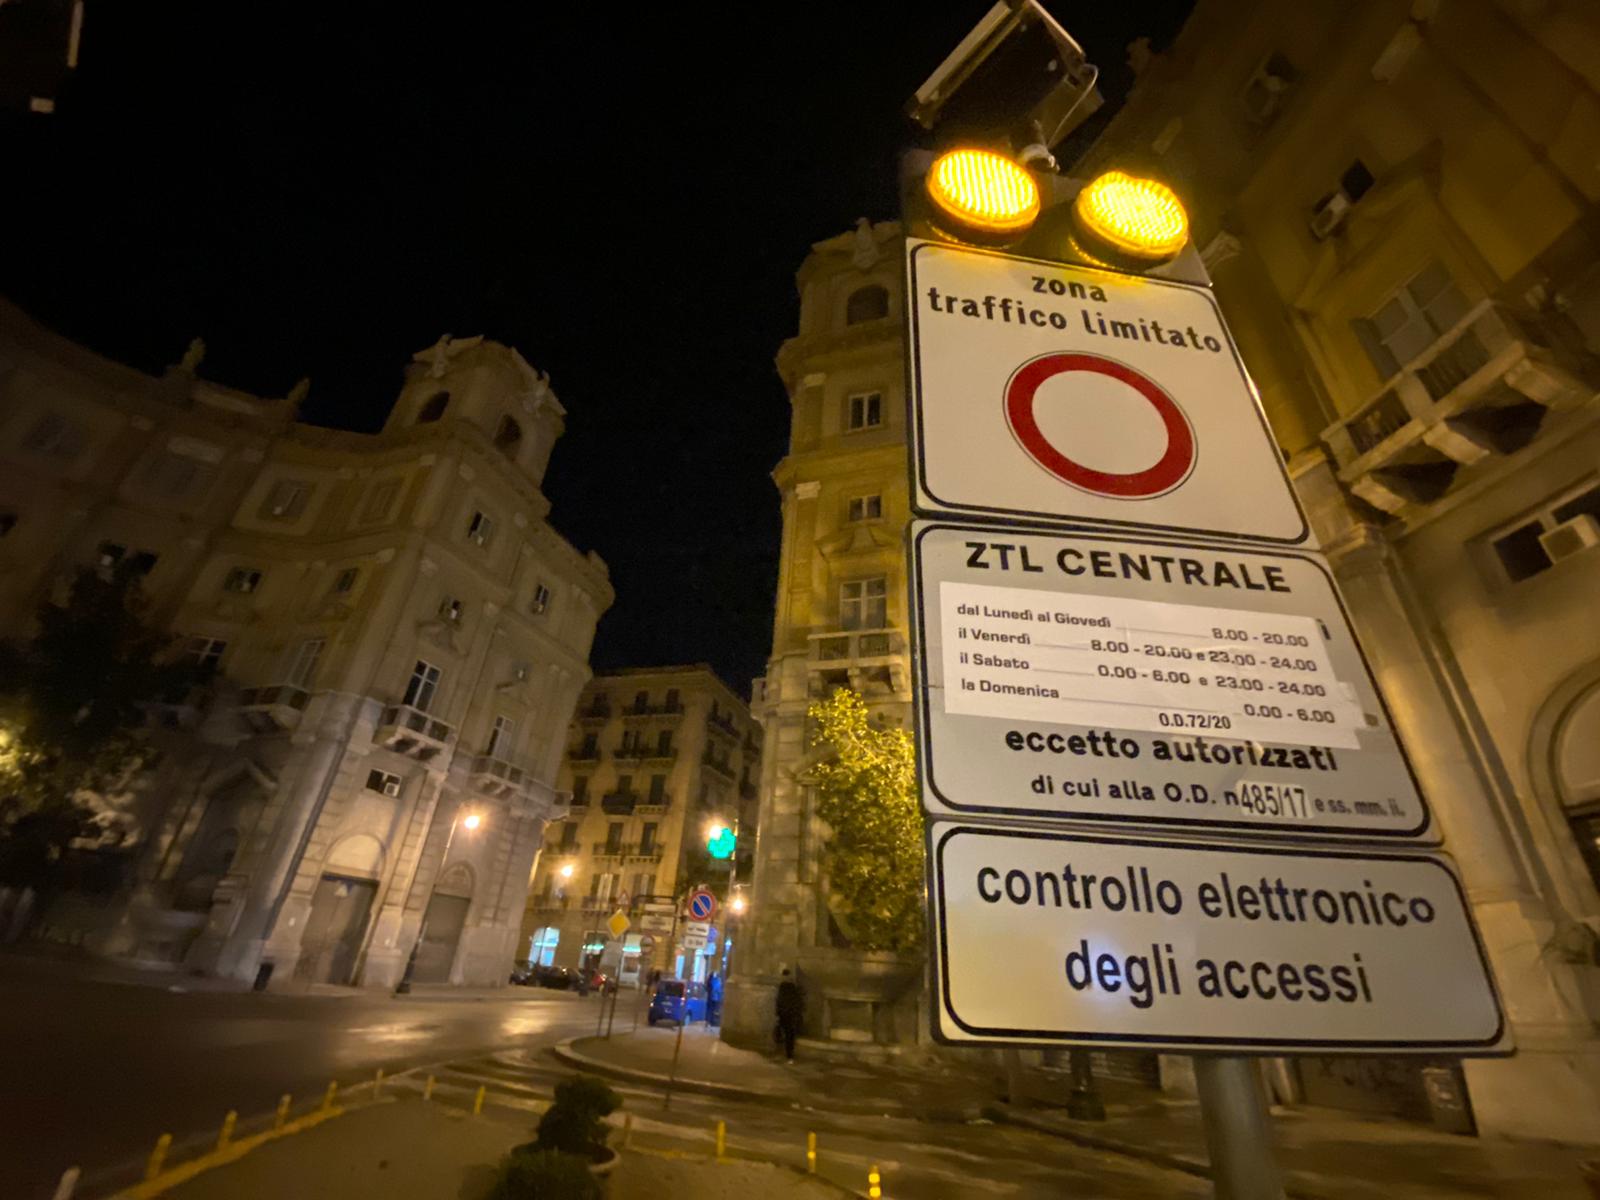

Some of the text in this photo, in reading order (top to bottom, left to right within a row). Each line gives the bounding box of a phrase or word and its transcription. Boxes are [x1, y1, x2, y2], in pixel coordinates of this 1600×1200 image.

[1032, 275, 1108, 302] zona
[928, 287, 1221, 352] traffico limitato
[965, 541, 1292, 593] ZTL CENTRALE
[957, 603, 980, 616] dal
[983, 605, 1033, 621] Lunedì
[1038, 611, 1051, 623] al
[1055, 613, 1111, 629] Giovedì
[1211, 628, 1248, 642] 8.00
[1262, 633, 1309, 647] 20.00
[958, 628, 967, 640] il
[971, 629, 1031, 645] Venerdì
[1091, 639, 1128, 654] 8.00
[1144, 645, 1193, 660] 20.00
[1196, 652, 1205, 662] e
[1209, 651, 1256, 667] 23.00
[1270, 657, 1317, 672] 24.00
[960, 652, 968, 664] il
[973, 654, 1030, 670] Sabato
[1097, 665, 1137, 680] 0.00
[1152, 670, 1191, 684] 6.00
[1199, 676, 1208, 686] e
[1216, 676, 1264, 691] 23.00
[1277, 682, 1326, 697] 24.00
[961, 678, 975, 692] la
[979, 679, 1060, 699] Domenica
[1244, 704, 1282, 719] 0.00
[1297, 709, 1336, 724] 6.00
[1005, 730, 1338, 771] eccetto autorizzati
[1031, 774, 1054, 795] di
[1062, 778, 1100, 798] cui
[1109, 780, 1156, 802] alla
[1163, 782, 1216, 805] O.D.
[1314, 799, 1325, 812] e
[977, 863, 1436, 927] controllo elettronico
[1064, 939, 1374, 1009] degli accessi
